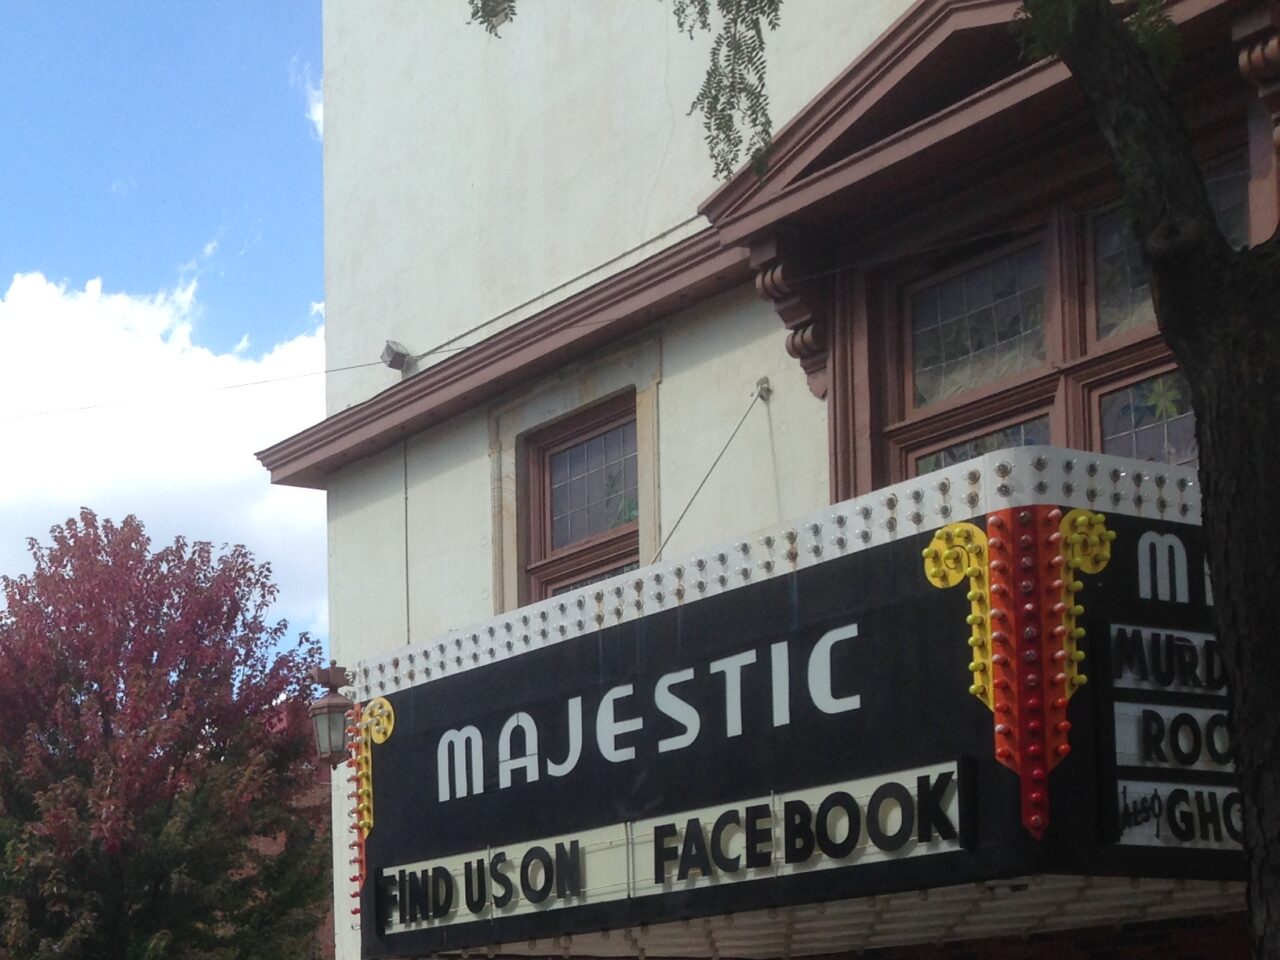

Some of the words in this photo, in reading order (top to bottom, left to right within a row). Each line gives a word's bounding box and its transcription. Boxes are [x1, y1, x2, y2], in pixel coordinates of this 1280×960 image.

[436, 623, 861, 802] MAJESTIC
[379, 866, 454, 930] FIND
[653, 770, 958, 885] FACEBOOK
